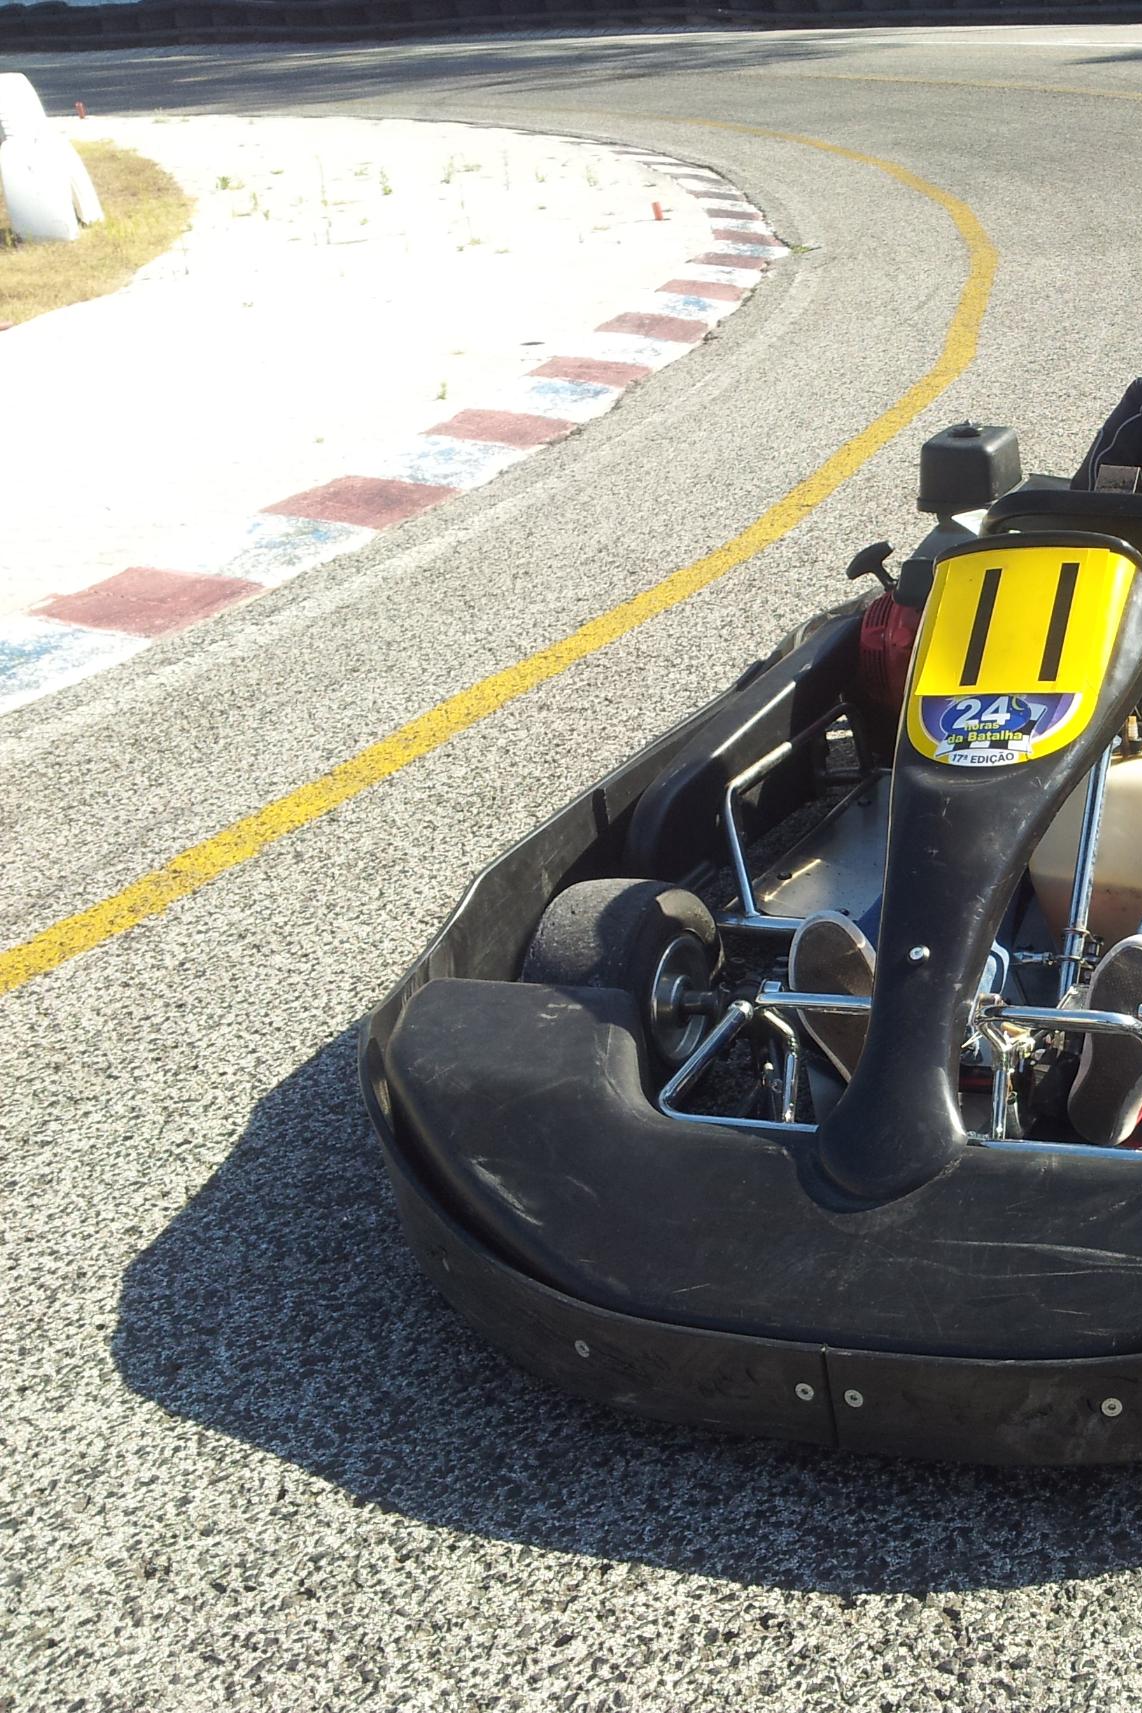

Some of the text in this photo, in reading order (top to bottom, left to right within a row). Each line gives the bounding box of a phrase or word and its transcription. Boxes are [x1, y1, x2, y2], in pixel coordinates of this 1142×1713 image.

[952, 695, 1010, 729] 24
[947, 729, 1023, 744] da Batalha
[970, 751, 1015, 764] EDIÇÃO
